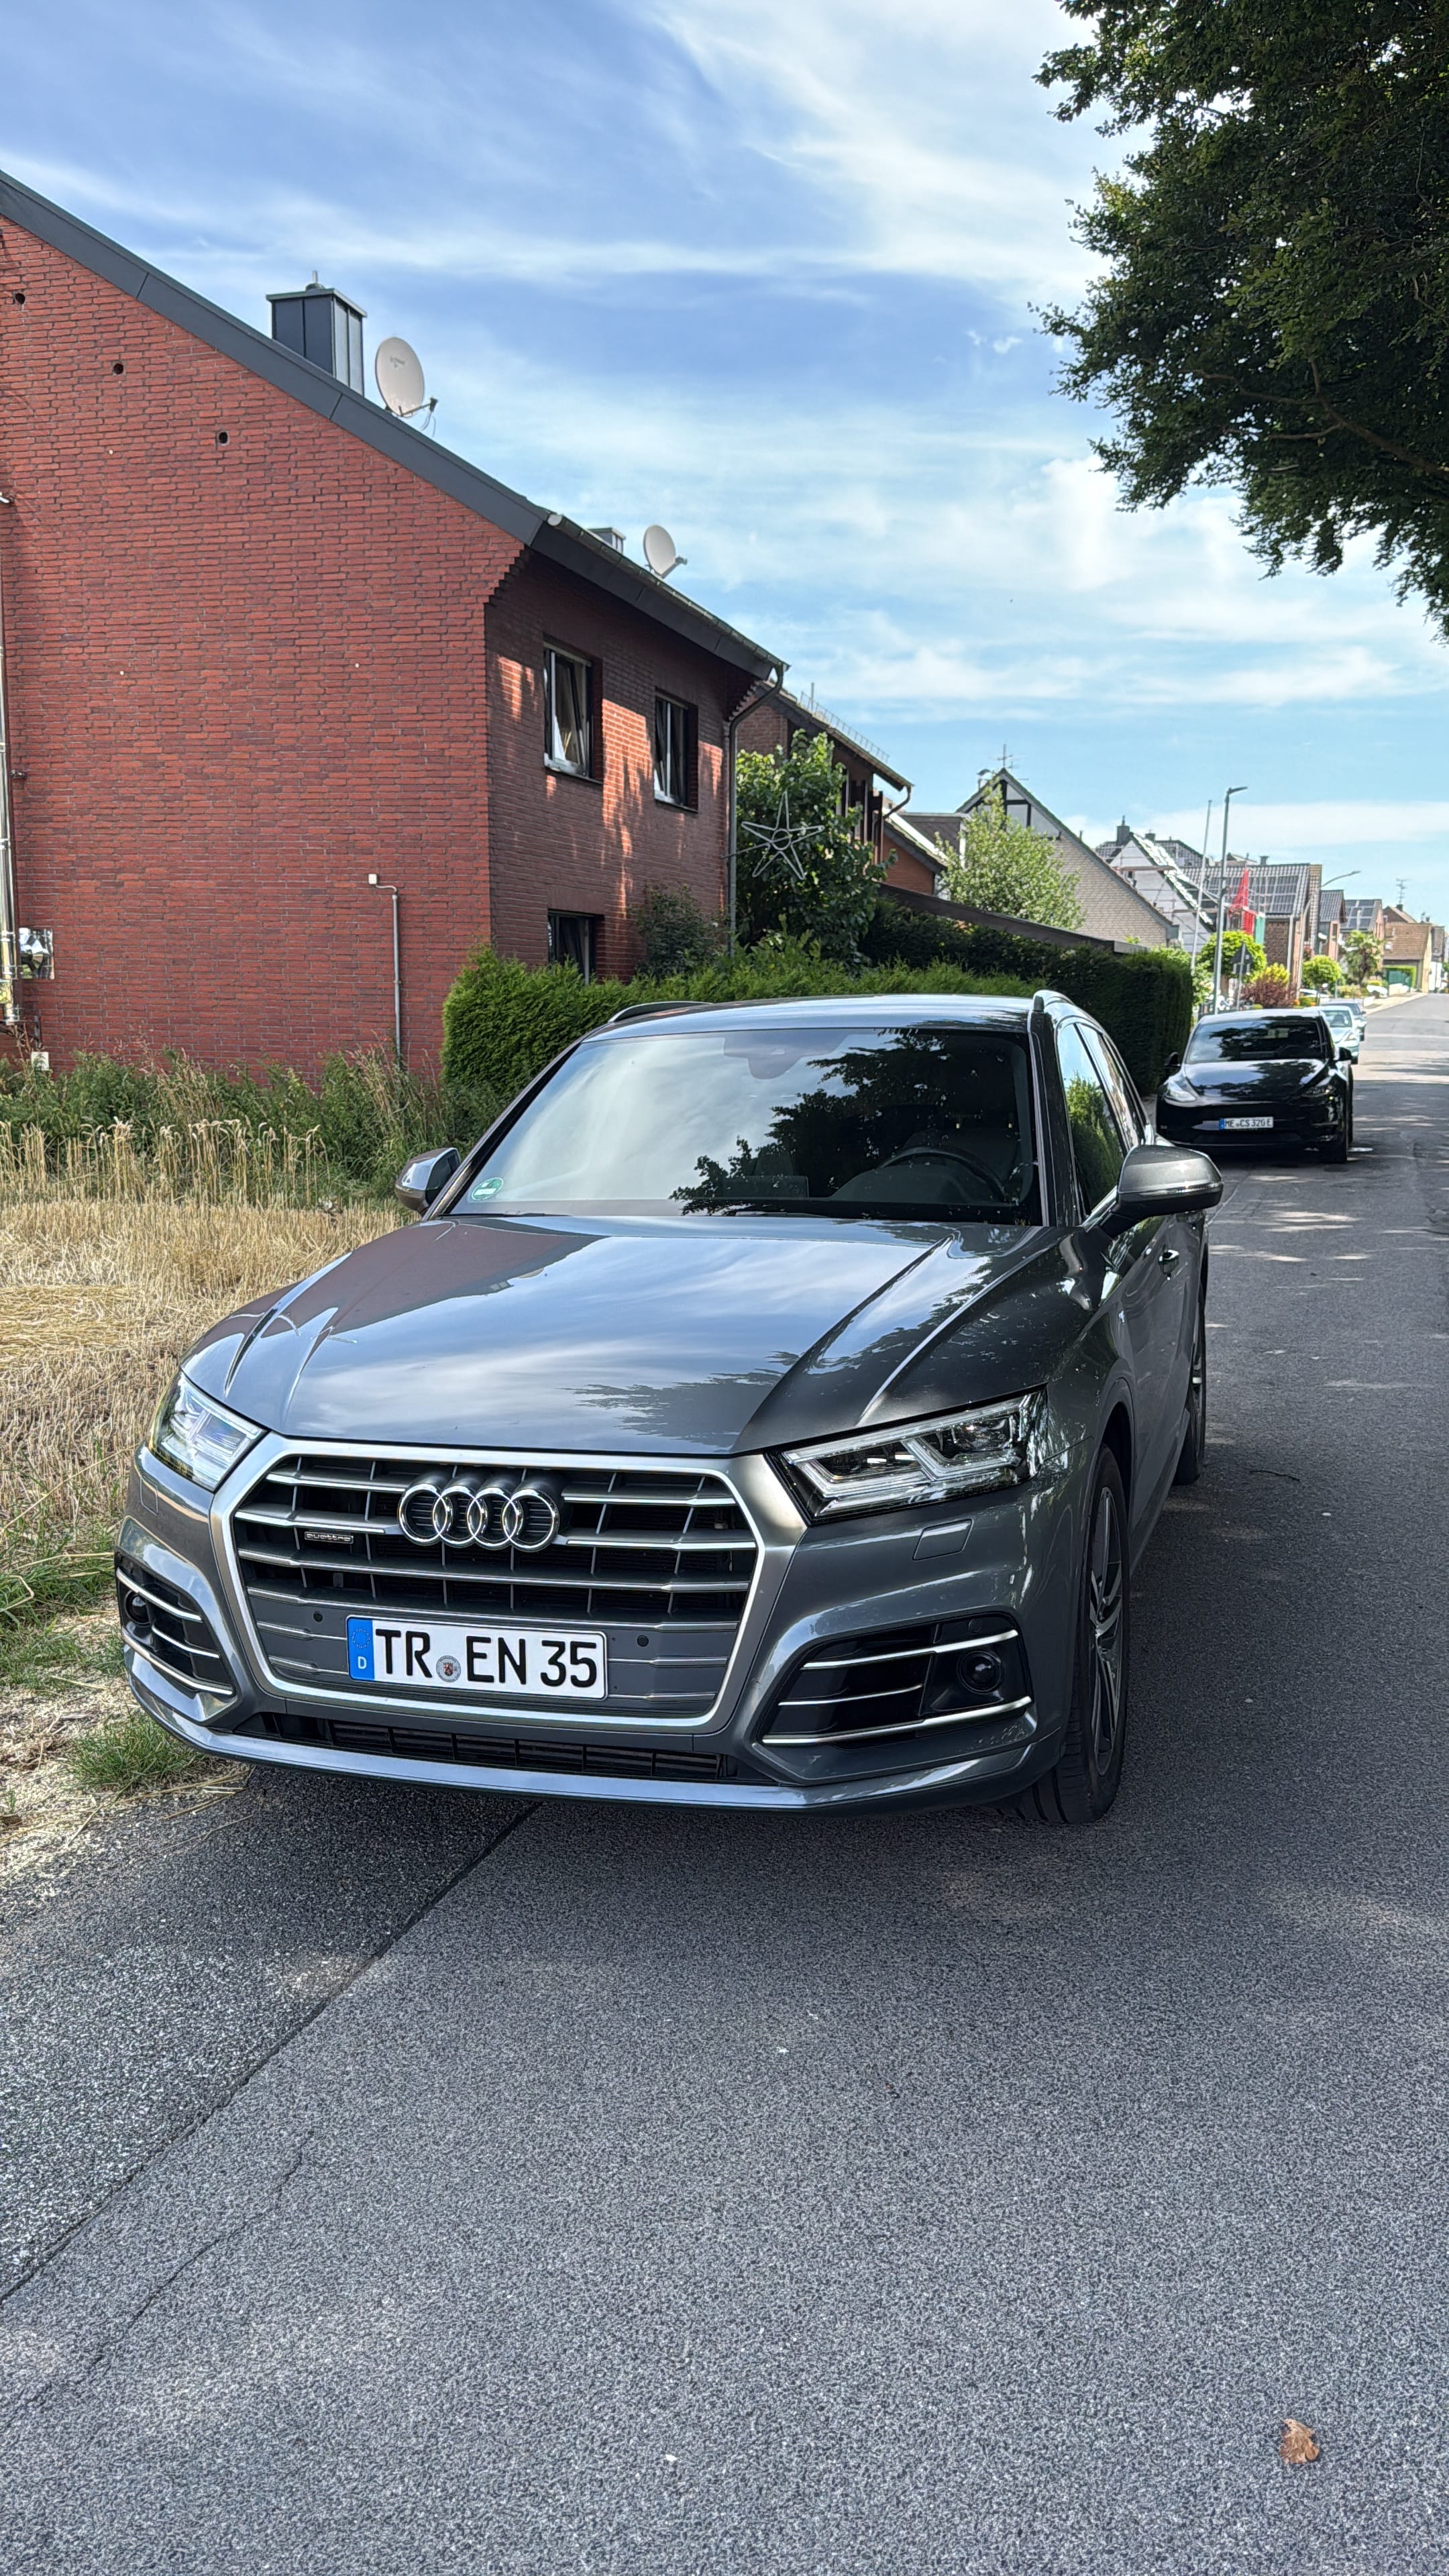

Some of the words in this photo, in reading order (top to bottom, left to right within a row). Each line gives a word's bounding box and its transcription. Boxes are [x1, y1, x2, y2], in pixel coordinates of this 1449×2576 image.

[306, 1534, 351, 1542] quattro
[358, 1656, 367, 1669] D
[376, 1629, 433, 1678] TR
[466, 1635, 527, 1684] EN
[541, 1640, 597, 1688] 35
